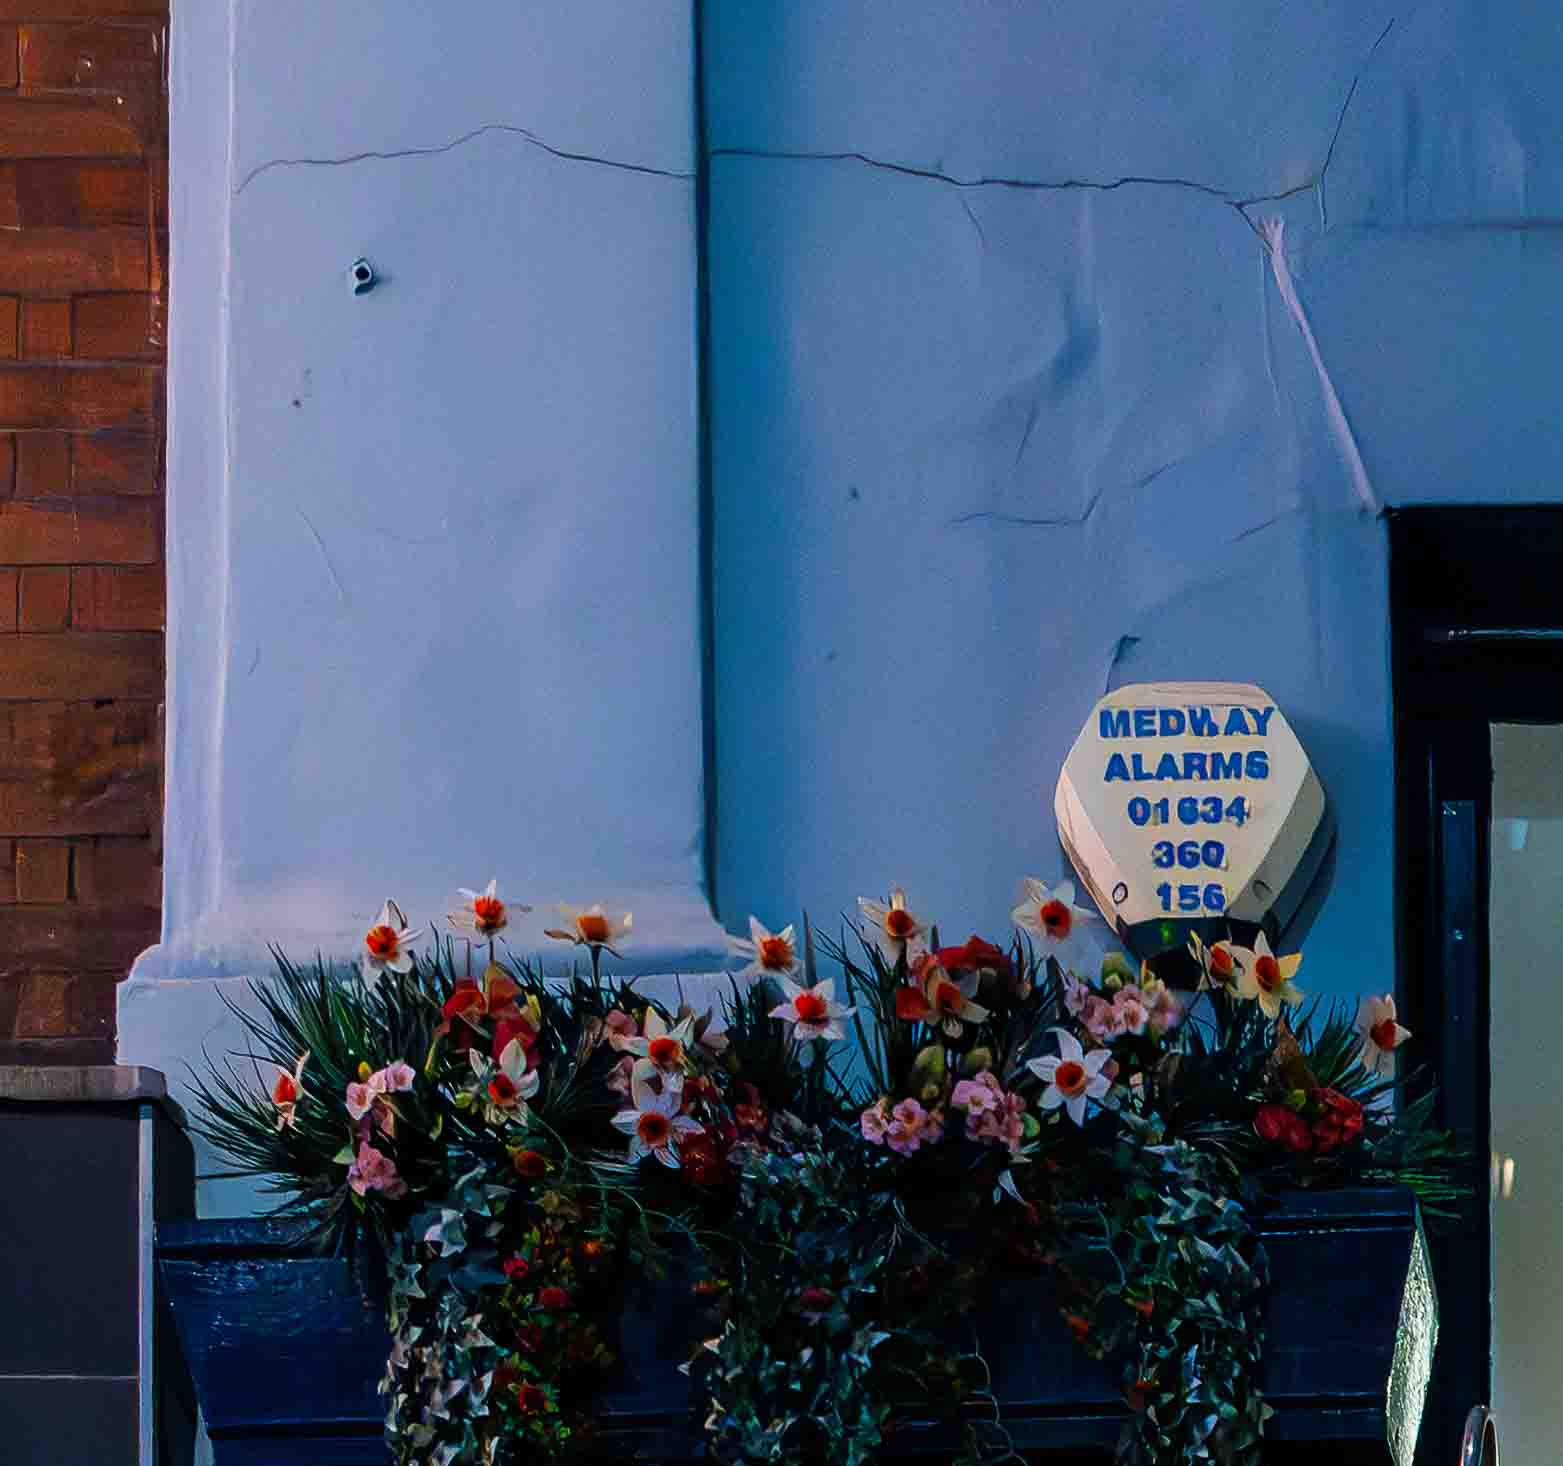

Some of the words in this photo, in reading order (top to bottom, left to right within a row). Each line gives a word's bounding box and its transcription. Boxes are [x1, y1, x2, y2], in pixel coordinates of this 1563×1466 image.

[1099, 706, 1274, 738] MEDWAY
[1104, 751, 1269, 782] ALARMS
[1127, 796, 1249, 826] 01634
[1153, 841, 1225, 869] 360
[1156, 883, 1226, 911] 156
